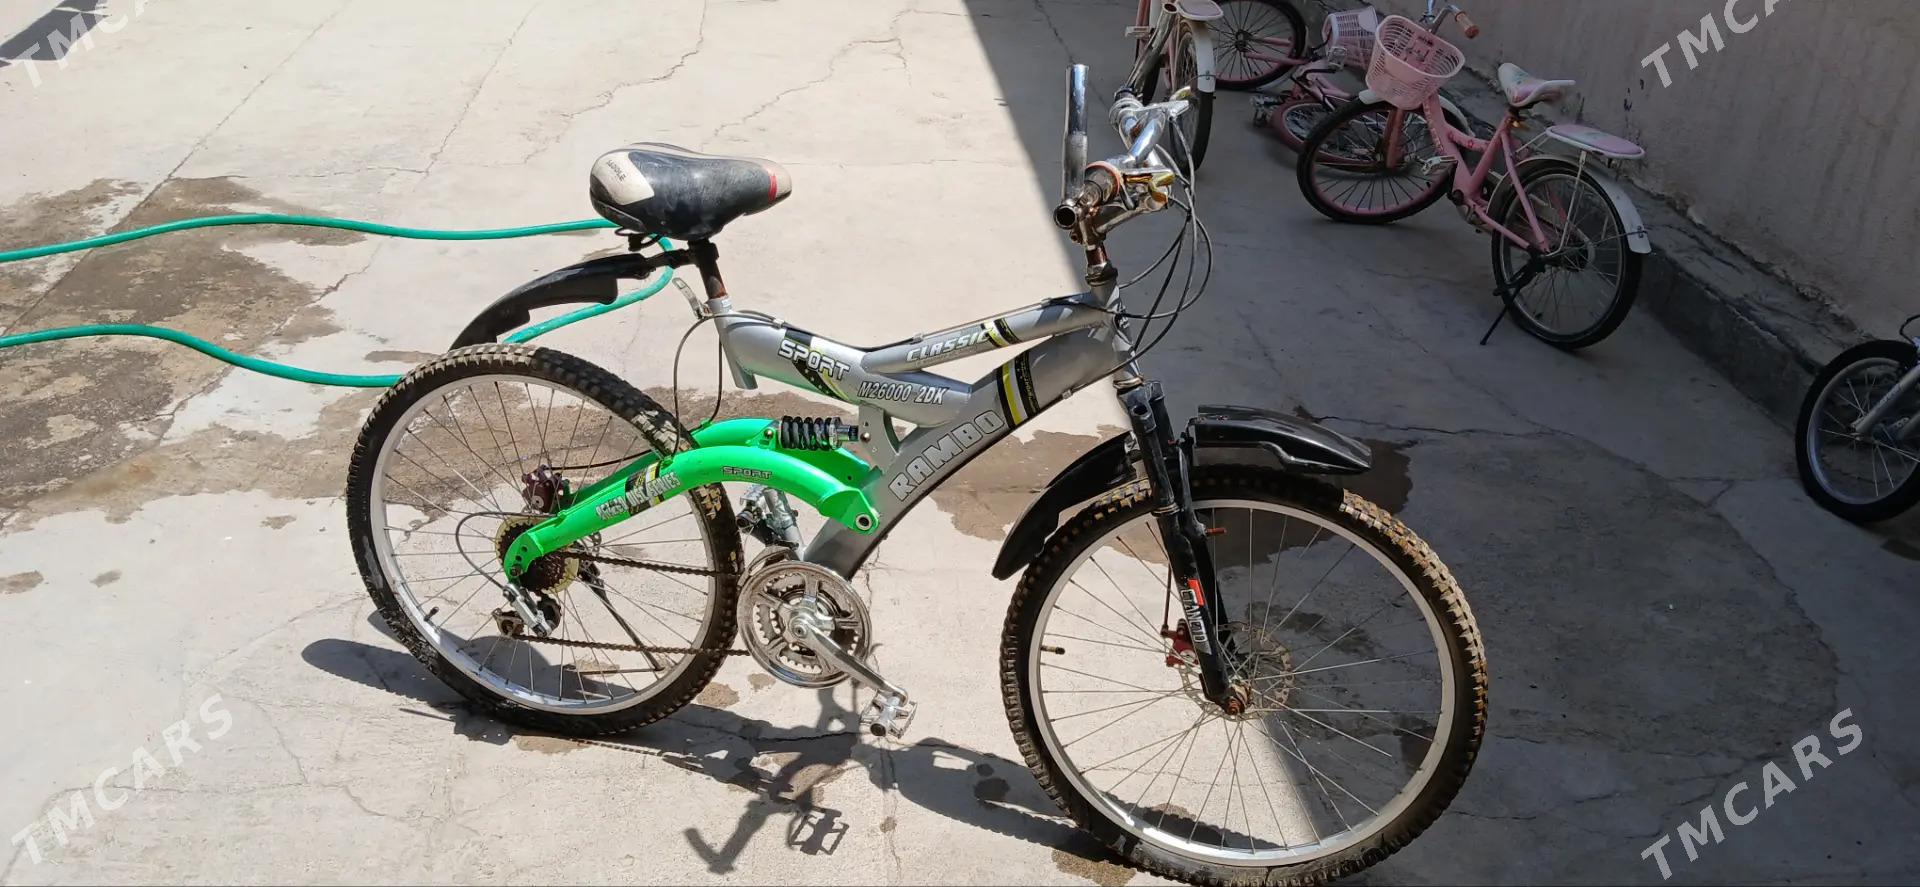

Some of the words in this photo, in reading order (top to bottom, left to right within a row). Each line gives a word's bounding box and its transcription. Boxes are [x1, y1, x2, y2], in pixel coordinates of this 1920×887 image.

[778, 338, 851, 382] SPORT
[906, 328, 991, 362] CLASSIC
[857, 380, 911, 403] M26000
[914, 385, 951, 405] 2DK
[888, 409, 1005, 501] RAMBO
[720, 466, 773, 480] SPORT
